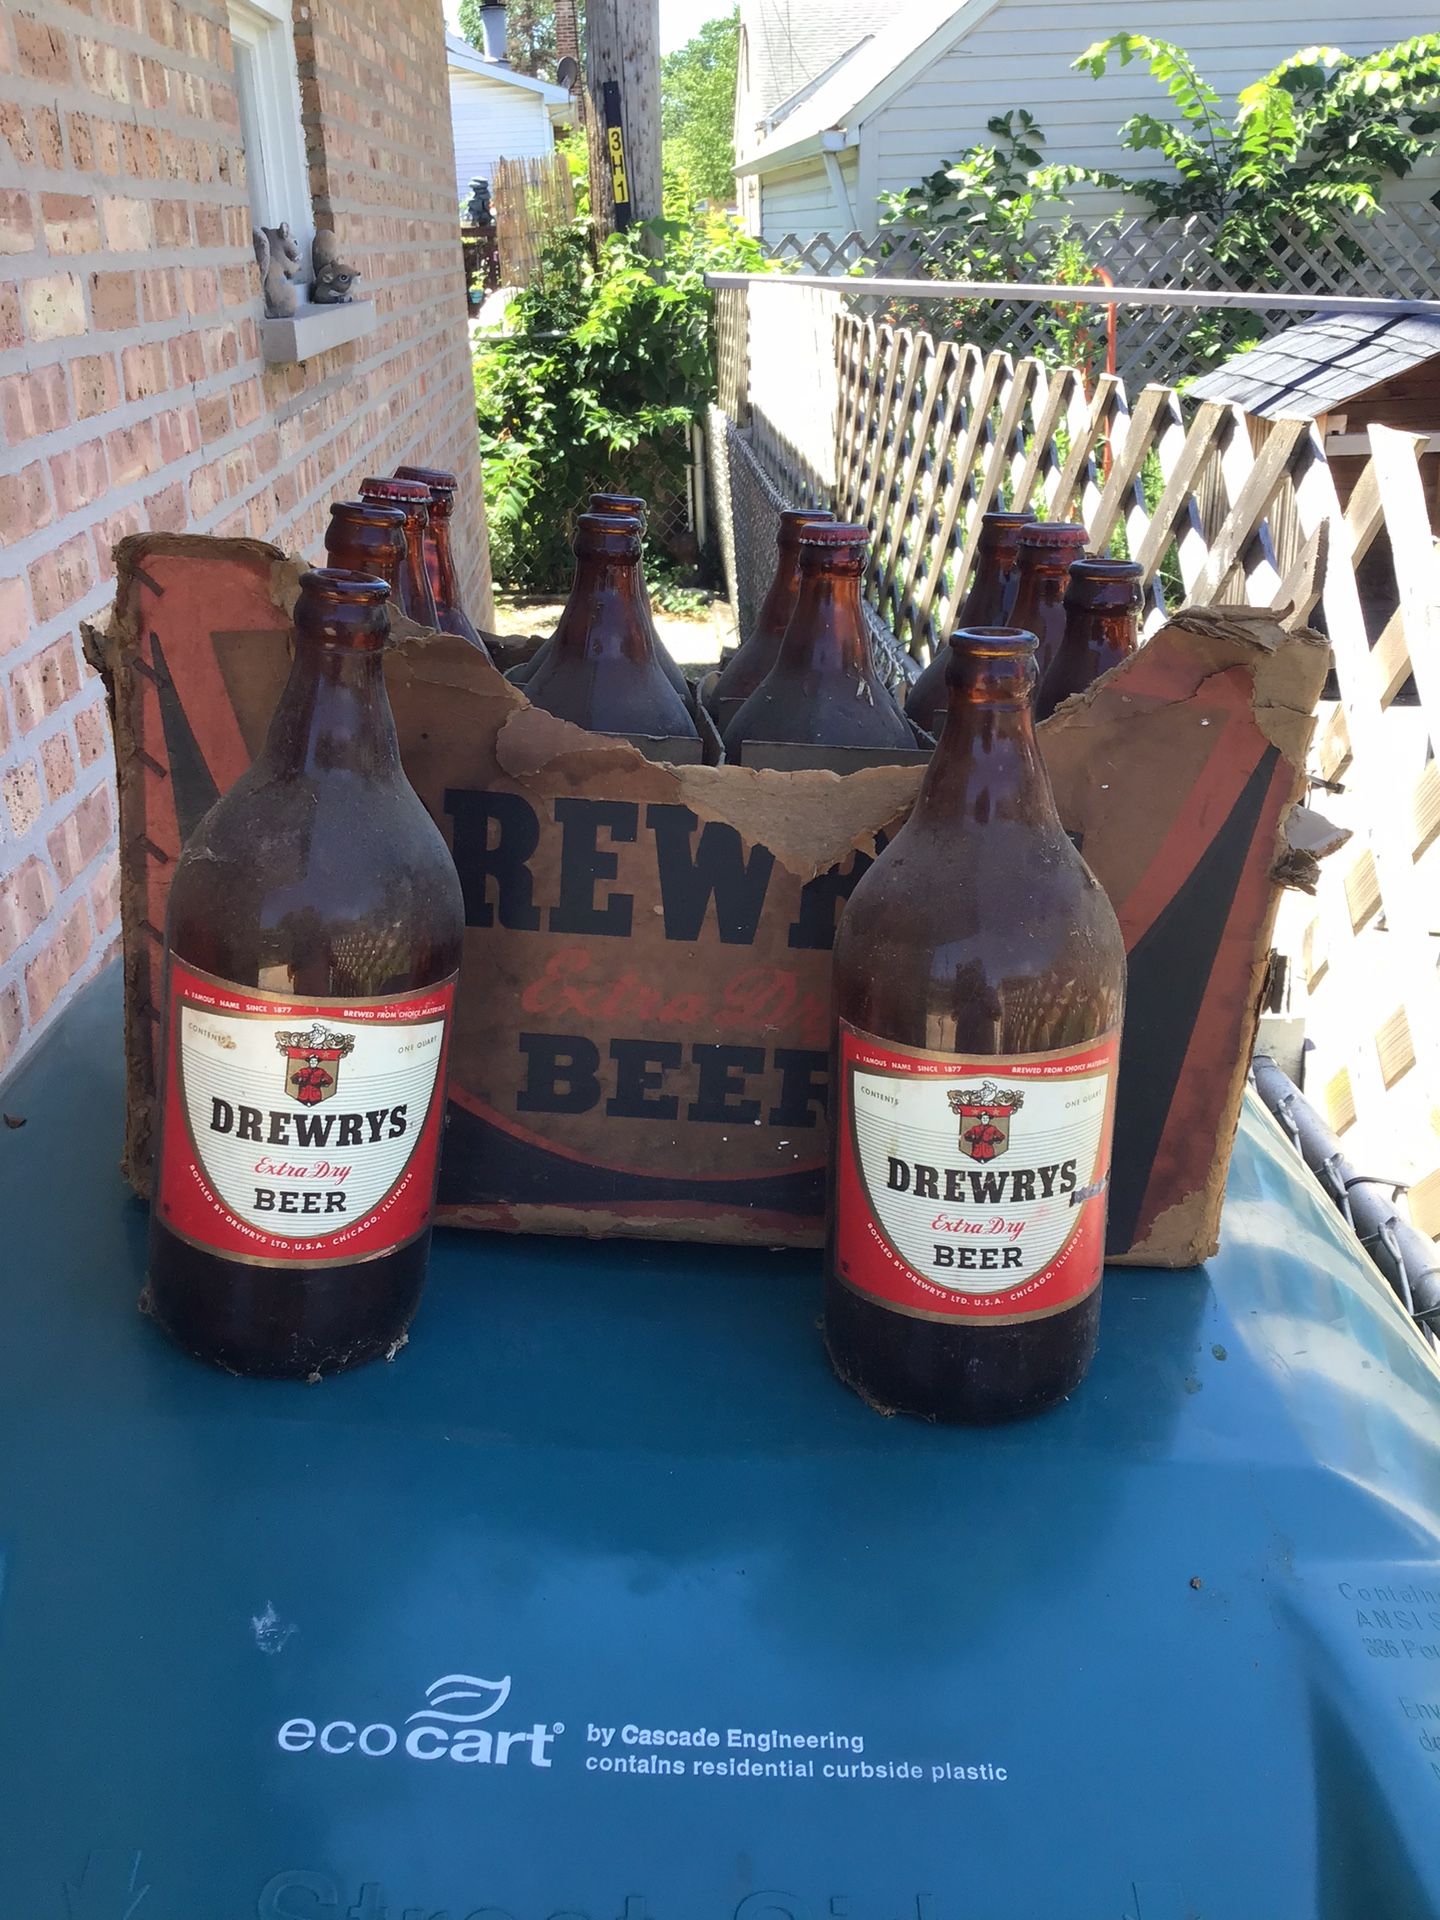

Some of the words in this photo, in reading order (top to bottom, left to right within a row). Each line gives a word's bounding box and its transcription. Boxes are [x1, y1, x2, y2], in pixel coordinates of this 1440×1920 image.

[520, 947, 698, 1025] Extra
[191, 992, 215, 1004] FAMOUS
[219, 1000, 240, 1010] NAME
[246, 1004, 267, 1012] SINCE
[343, 1009, 374, 1018] BREWED
[399, 1010, 421, 1018] CHOICE
[398, 1044, 414, 1054] ONE
[417, 1035, 438, 1049] QUART
[863, 1056, 888, 1067] FAMOUS
[891, 1062, 912, 1071] NAME
[917, 1065, 938, 1073] SINCE
[1011, 1066, 1042, 1074] BREWED
[1064, 1064, 1086, 1073] CHOICE
[861, 1086, 899, 1106] CONTENTS
[1064, 1099, 1080, 1109] ONE
[209, 1096, 408, 1147] DREWRYS
[254, 1156, 308, 1178] Extra
[312, 1160, 352, 1186] Dry
[886, 1156, 1077, 1204] DREWRYS
[189, 1164, 214, 1202] BOTTLED
[213, 1203, 225, 1215] BY
[225, 1215, 267, 1243] DREWRYS
[271, 1239, 291, 1250] LTD.
[294, 1242, 326, 1251] U.S.A.
[382, 1172, 414, 1213] ILLINOIS
[253, 1187, 347, 1214] BEER
[931, 1213, 984, 1234] Extra
[987, 1216, 1026, 1241] Dry
[867, 1222, 893, 1259] BOTTLED
[893, 1260, 905, 1271] BY
[905, 1271, 947, 1299] DREWRYS
[951, 1295, 970, 1305] LTD.
[974, 1298, 1004, 1306] U.S.A.
[1056, 1228, 1084, 1268] ILLINOIS
[933, 1244, 1023, 1270] BEER
[1355, 1608, 1424, 1631] ANSI
[587, 1724, 616, 1747] by
[621, 1724, 720, 1748] Cascade
[727, 1728, 864, 1753] Engineering
[586, 1755, 685, 1775] contains
[693, 1758, 814, 1778] residential
[822, 1761, 923, 1780] curbside
[932, 1763, 1008, 1783] plastic
